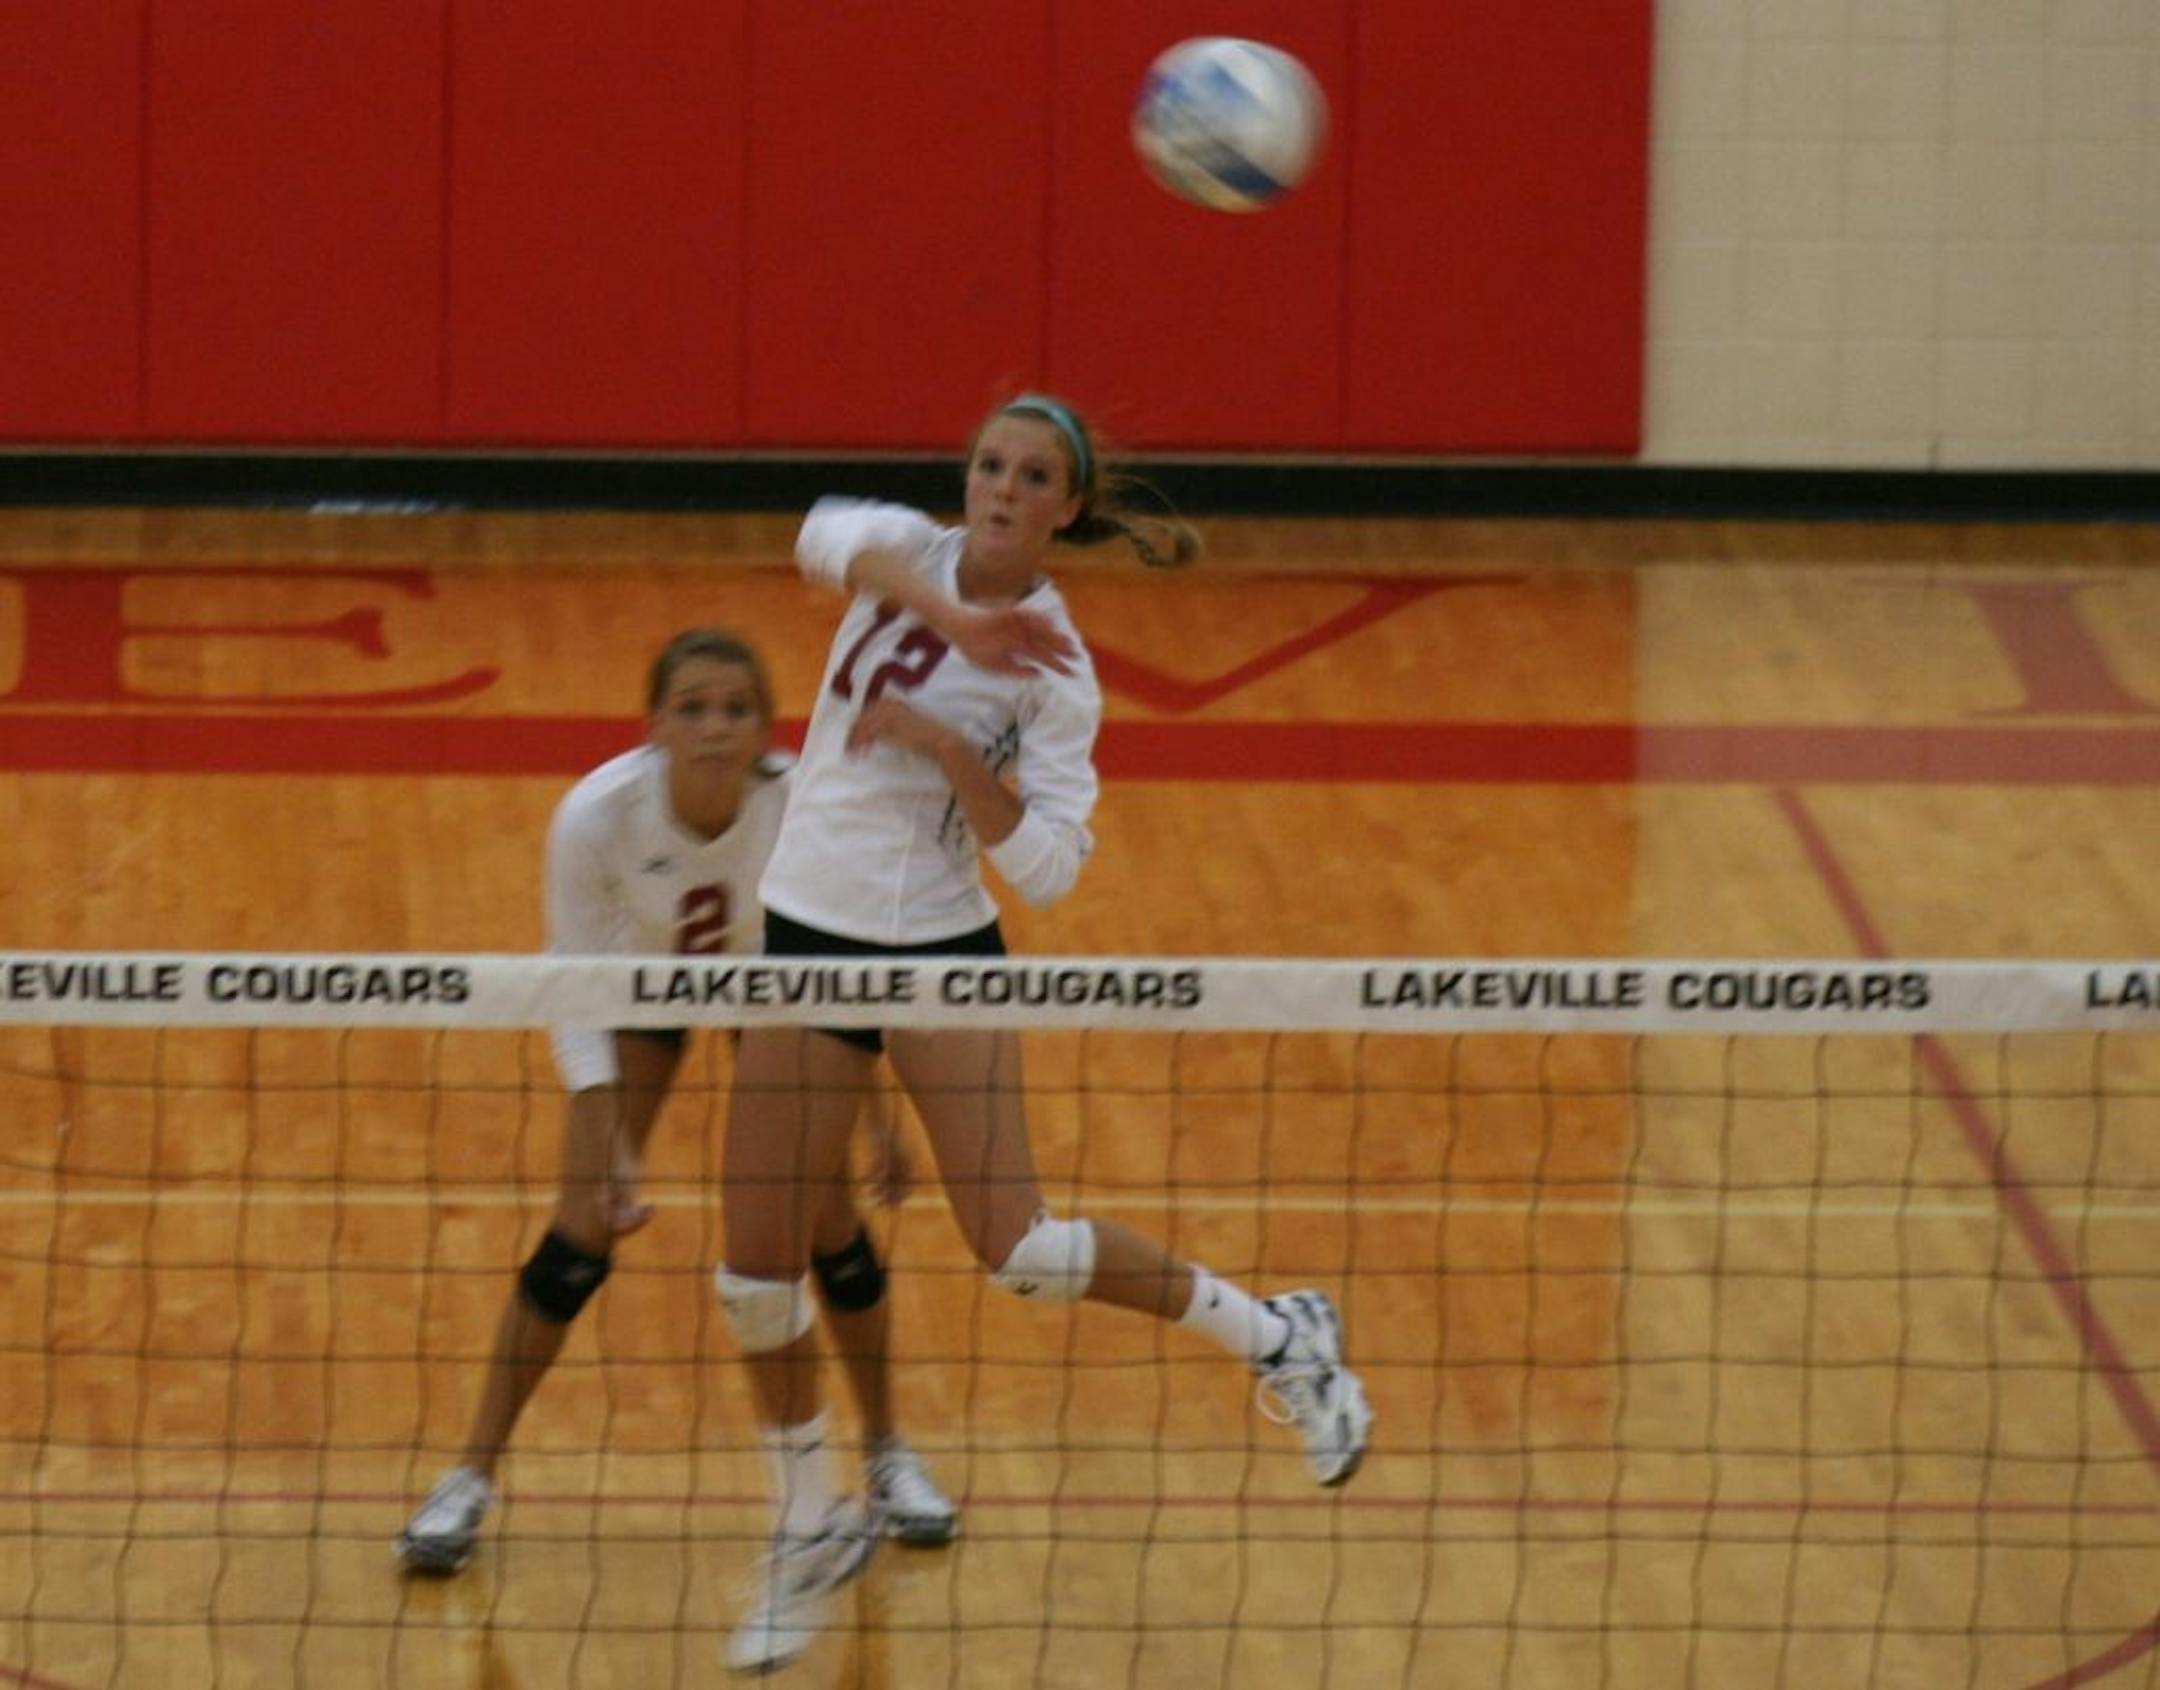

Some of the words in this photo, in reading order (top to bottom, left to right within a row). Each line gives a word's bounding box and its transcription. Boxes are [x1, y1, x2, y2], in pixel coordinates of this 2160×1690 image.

[675, 883, 732, 956] 2
[0, 963, 182, 1001] EVILLE
[207, 965, 470, 1003] COUGARS
[632, 967, 917, 1004] LAKEVILLE
[940, 970, 1203, 1007] COUGARS
[1361, 969, 1645, 1008] LAKEVILLE
[1668, 972, 1932, 1011] COUGARS
[2086, 971, 2160, 1010] LA
